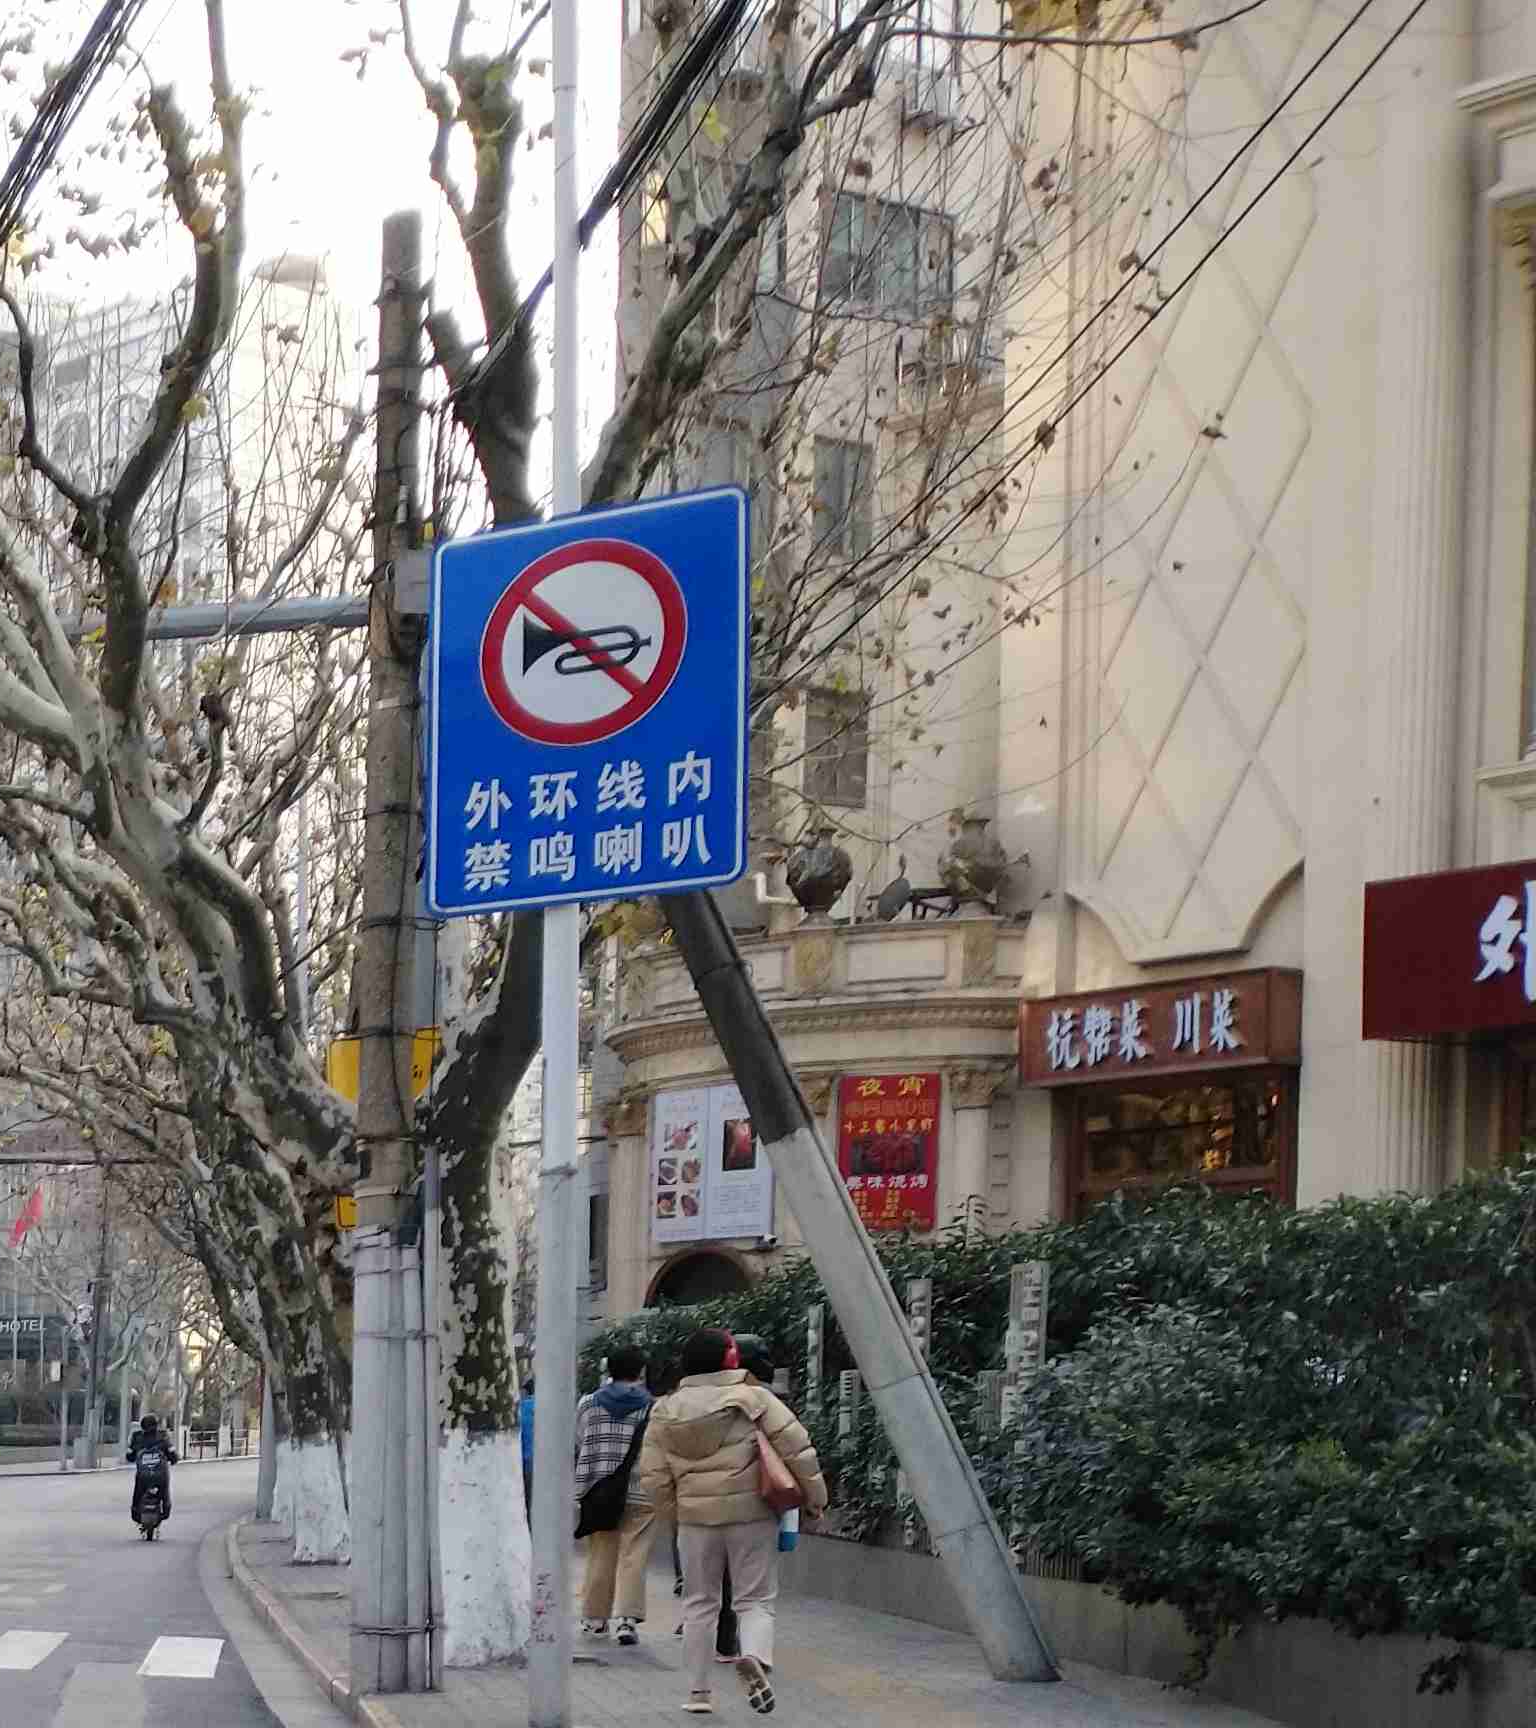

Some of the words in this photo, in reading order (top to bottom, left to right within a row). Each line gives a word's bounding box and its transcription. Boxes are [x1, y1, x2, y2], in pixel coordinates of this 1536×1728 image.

[464, 750, 712, 831] 外环线内
[464, 813, 712, 892] 禁鸣喇叭
[0, 1318, 47, 1334] HOTEL
